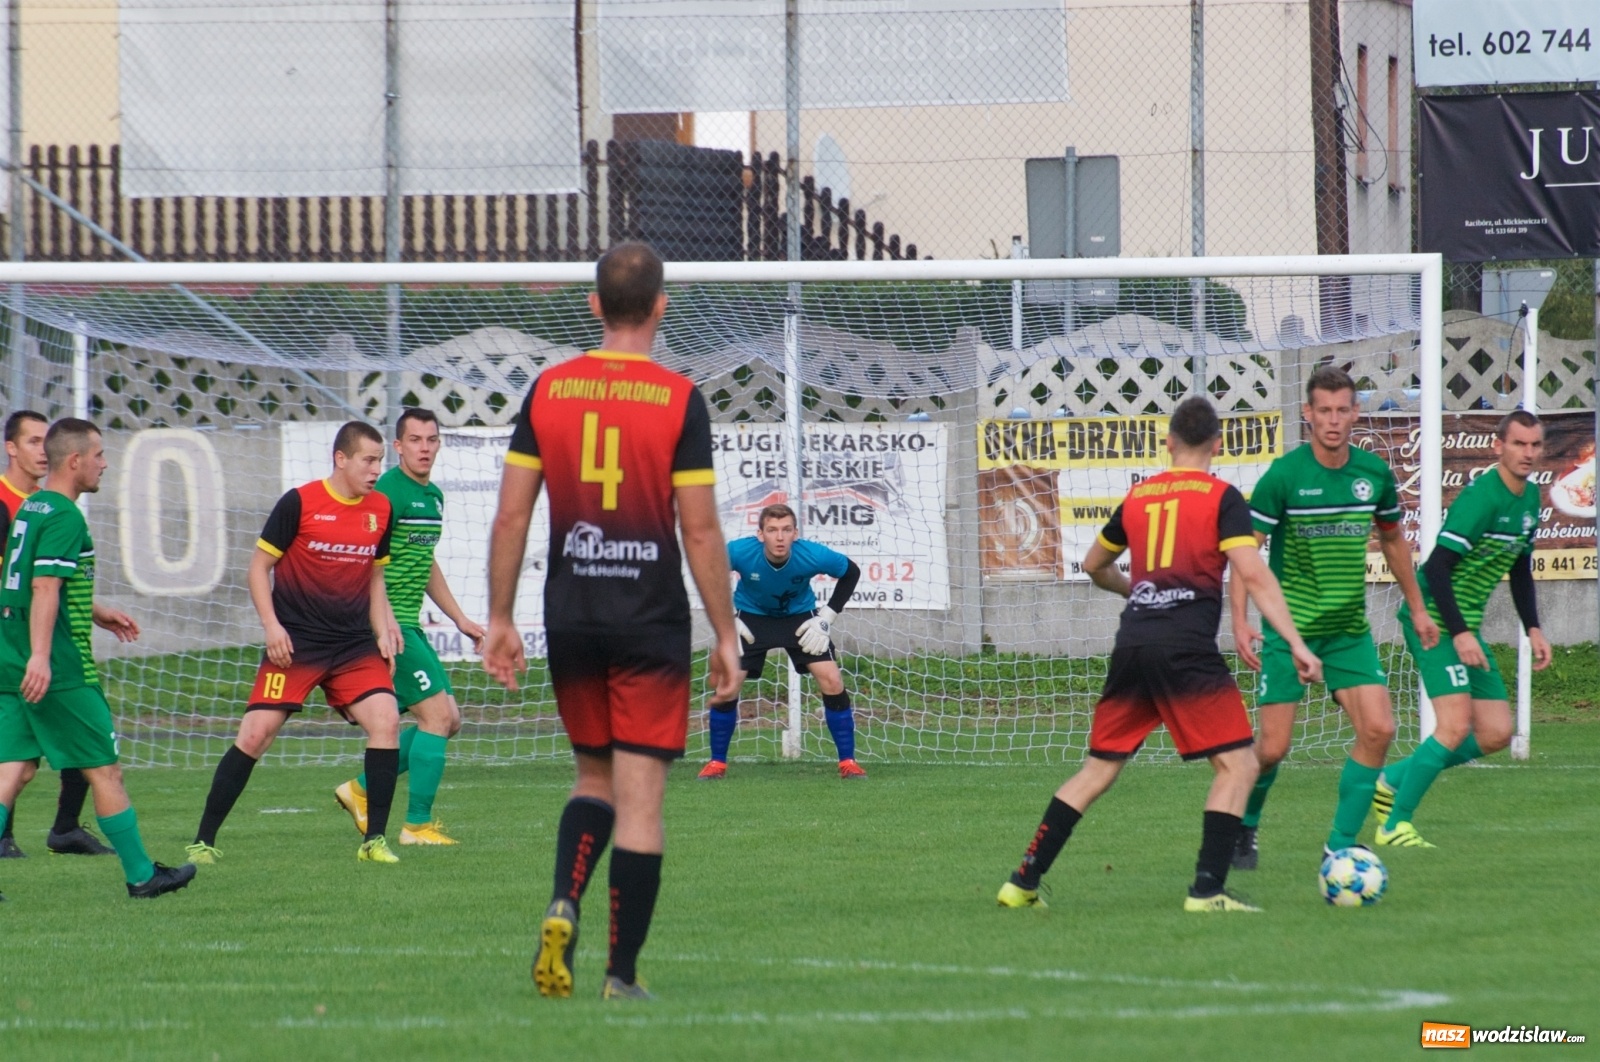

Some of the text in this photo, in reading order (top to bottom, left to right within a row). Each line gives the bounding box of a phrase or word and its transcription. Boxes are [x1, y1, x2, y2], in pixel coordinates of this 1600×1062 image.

[1429, 28, 1591, 57] tel. 602 744
[1503, 217, 1540, 225] Mickiewicza
[581, 411, 623, 510] 4
[739, 460, 885, 479] CIESELSKIE
[1144, 498, 1180, 572] 11
[5, 519, 28, 590] 2
[1551, 557, 1576, 571] 441
[868, 562, 915, 582] 012
[893, 588, 904, 602] 8
[263, 672, 286, 700] 19
[413, 670, 431, 692] 3
[1446, 664, 1470, 687] 13
